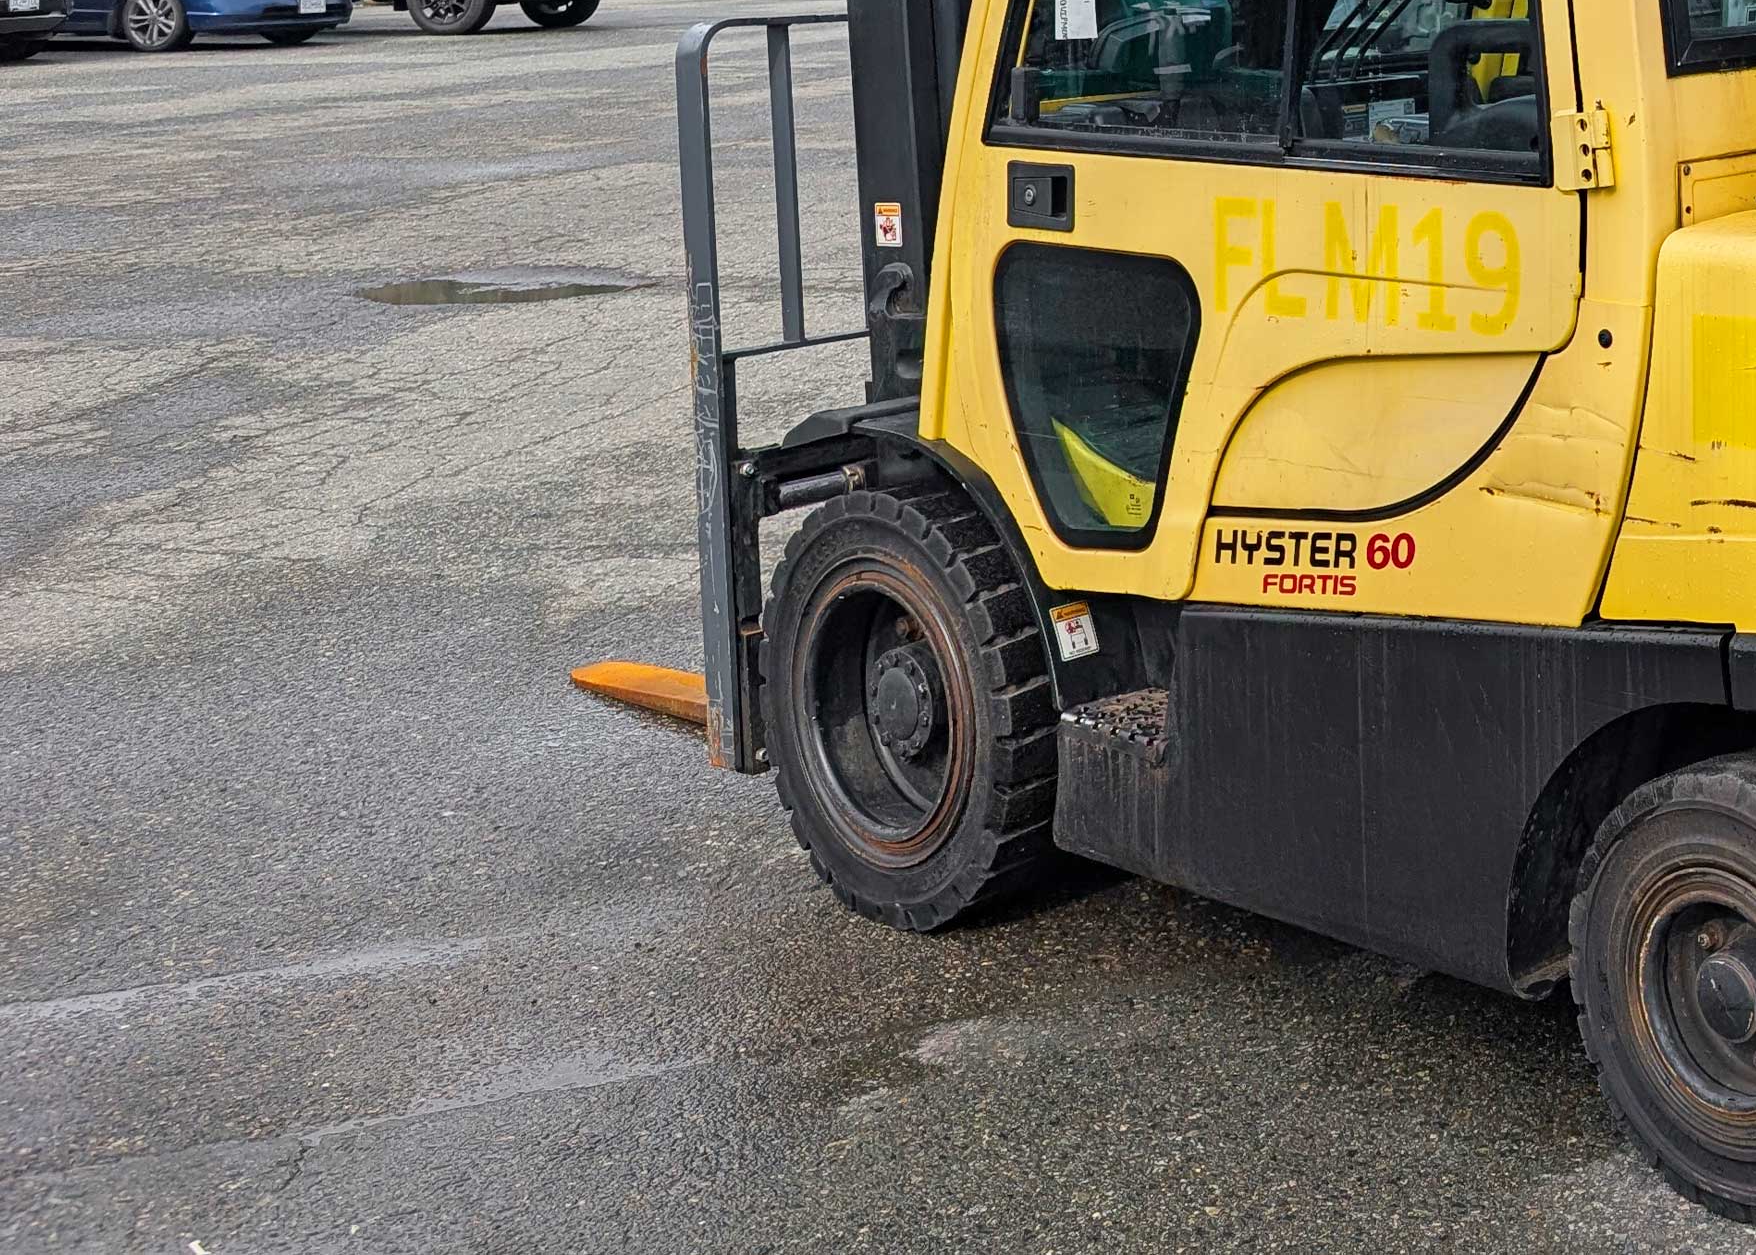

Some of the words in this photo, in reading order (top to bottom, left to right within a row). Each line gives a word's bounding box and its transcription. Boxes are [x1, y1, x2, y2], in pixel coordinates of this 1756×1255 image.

[1213, 196, 1521, 336] FLM19
[1214, 528, 1357, 569] HYSTER
[1366, 532, 1416, 570] 60
[1262, 573, 1357, 596] FORTIS
